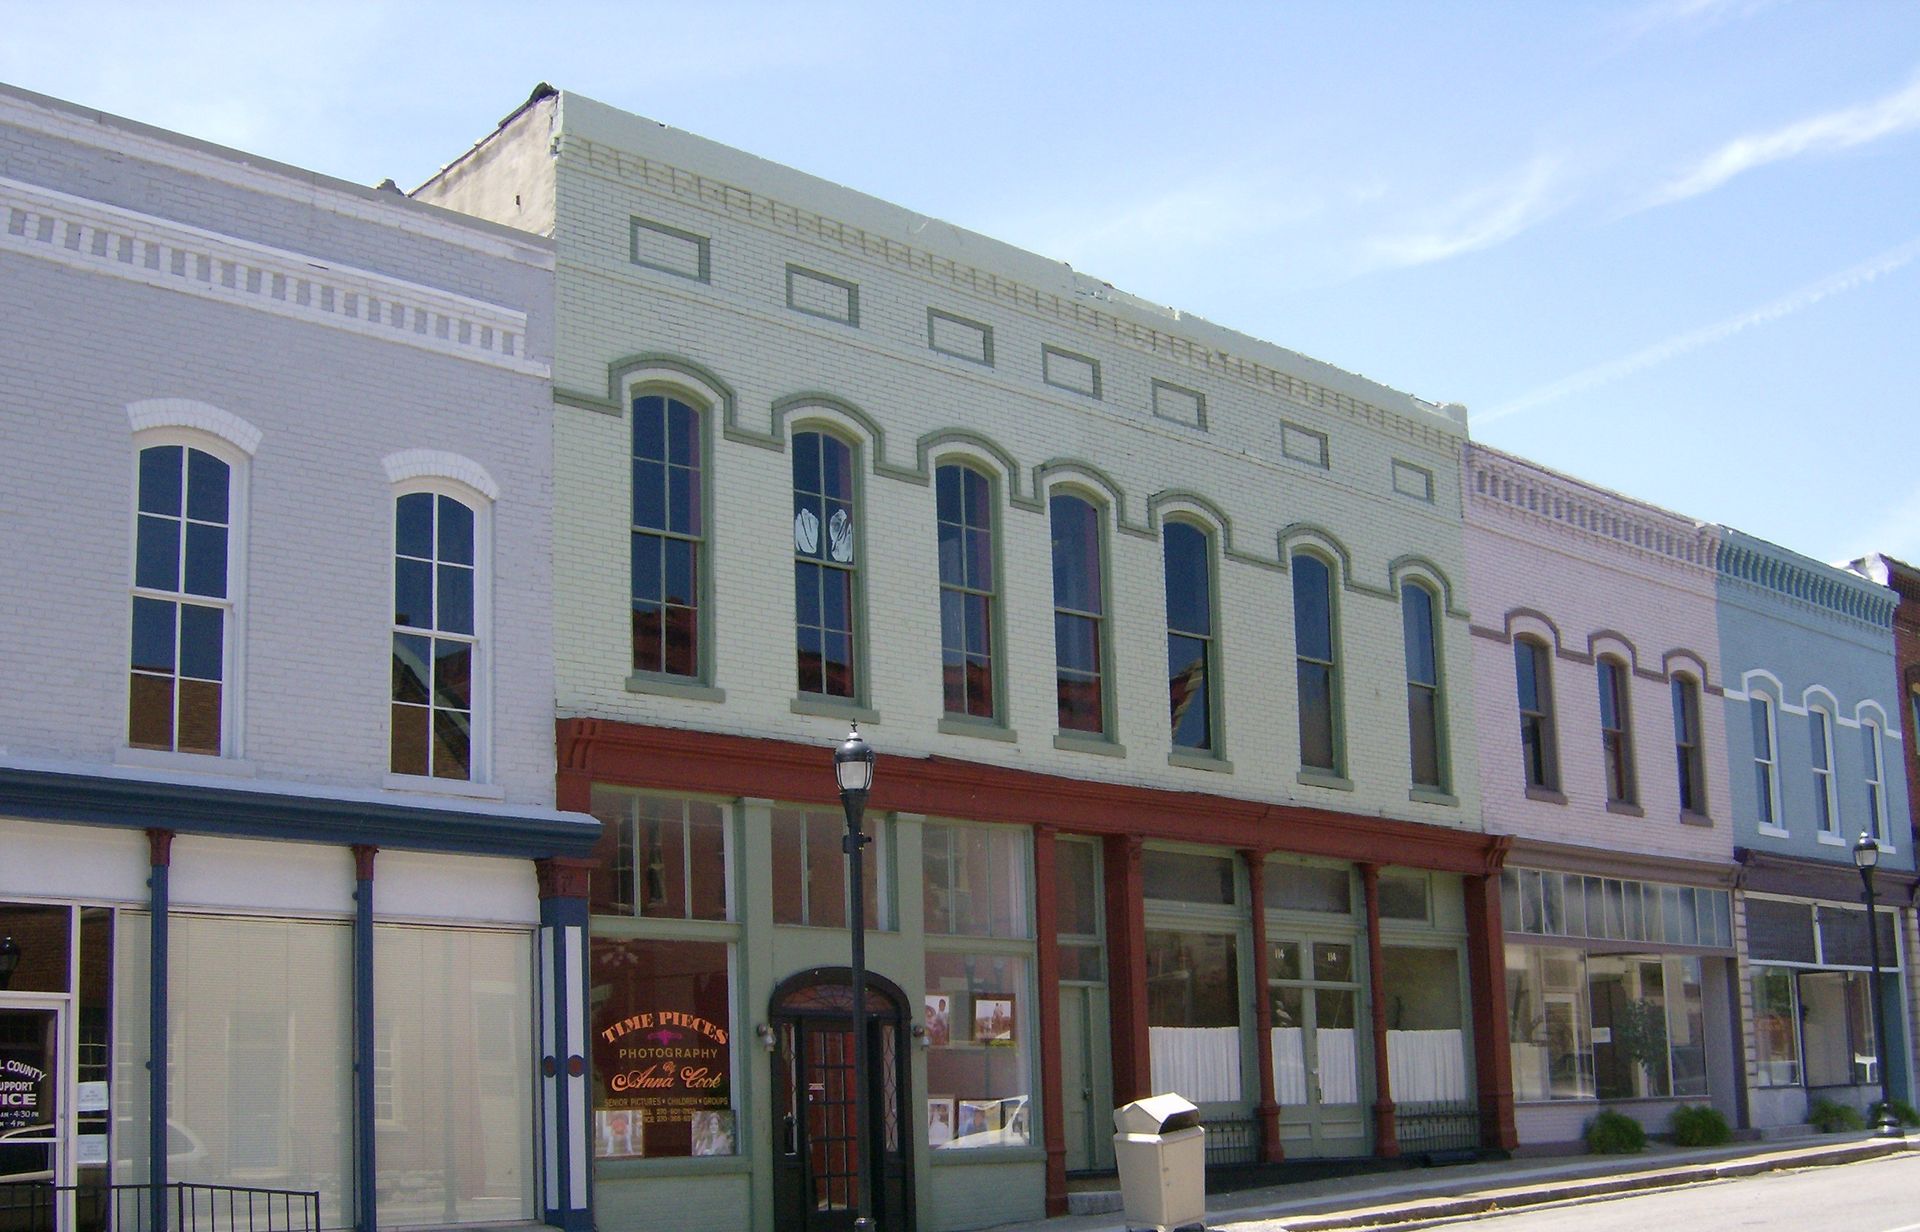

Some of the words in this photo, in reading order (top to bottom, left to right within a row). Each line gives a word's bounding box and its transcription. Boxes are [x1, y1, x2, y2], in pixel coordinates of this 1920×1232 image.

[602, 1013, 654, 1043] TIME
[659, 1011, 729, 1045] PIECES
[619, 1047, 718, 1059] PHOTOGRAPHY
[7, 1060, 47, 1081] COUNTY
[611, 1064, 675, 1092] Anna
[680, 1066, 722, 1089] Cook
[0, 1081, 34, 1091] UPPORT
[0, 1093, 37, 1105] ICE
[630, 1097, 661, 1106] PICTURES
[667, 1097, 698, 1106] CHILDREN
[703, 1096, 729, 1105] GROUPS
